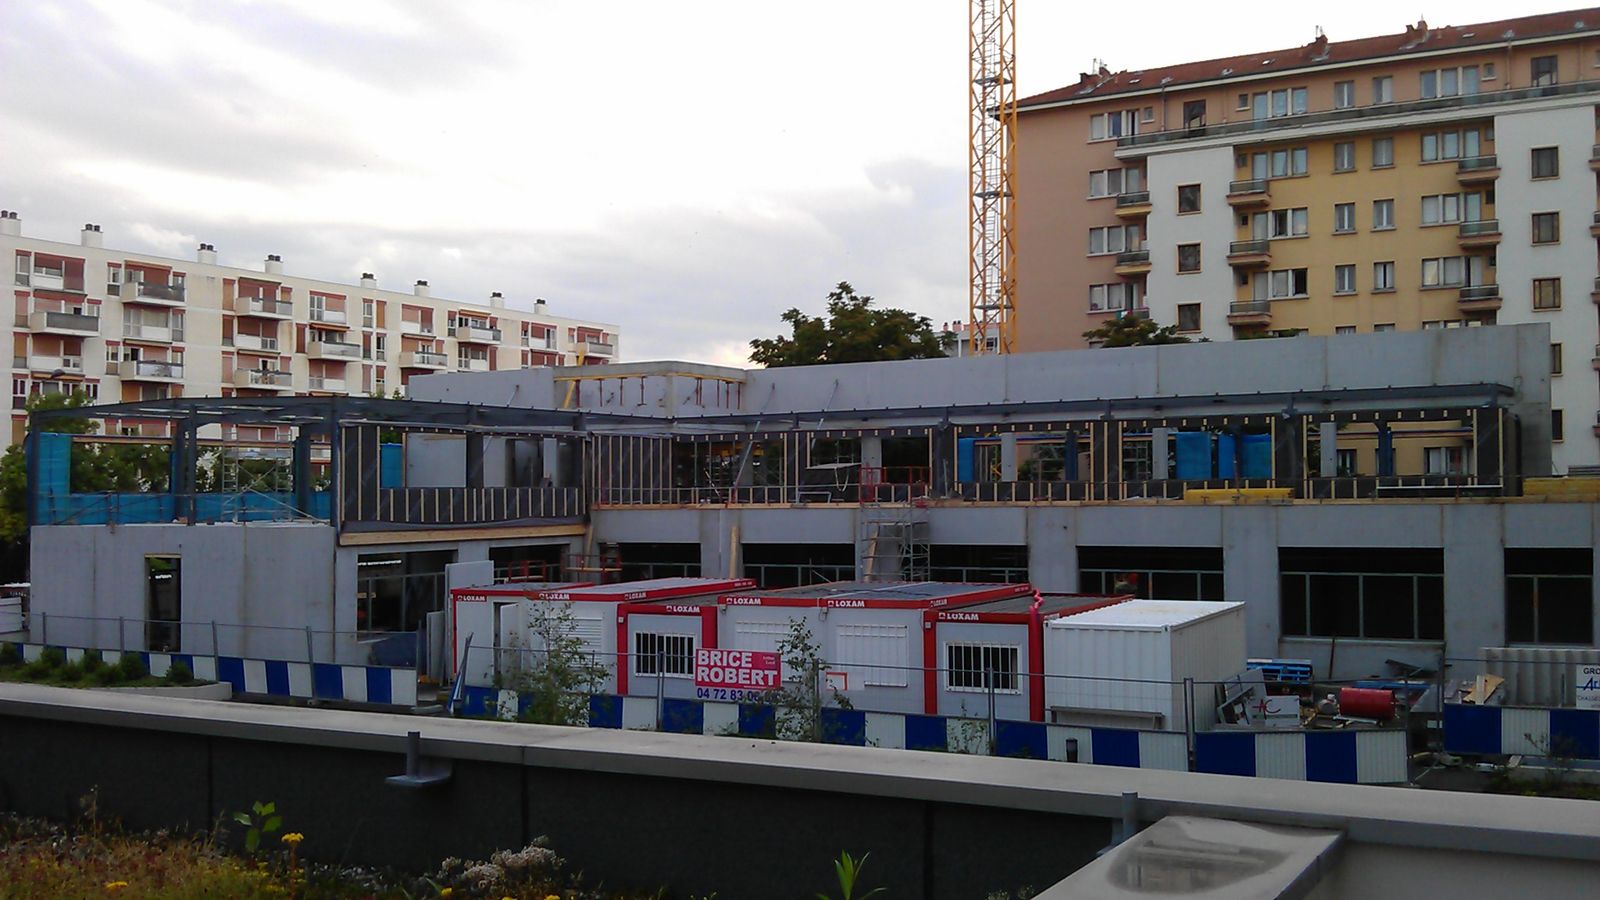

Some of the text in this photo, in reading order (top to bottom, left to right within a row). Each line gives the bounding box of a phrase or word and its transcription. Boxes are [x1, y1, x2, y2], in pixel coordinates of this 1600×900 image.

[629, 592, 647, 600] LOXAM
[835, 600, 865, 608] LOXAM
[946, 613, 979, 621] LOXAM
[697, 650, 752, 668] BRICE
[697, 666, 778, 686] ROBERT
[697, 688, 710, 699] 04
[713, 689, 727, 700] 72
[730, 690, 743, 701] 83
